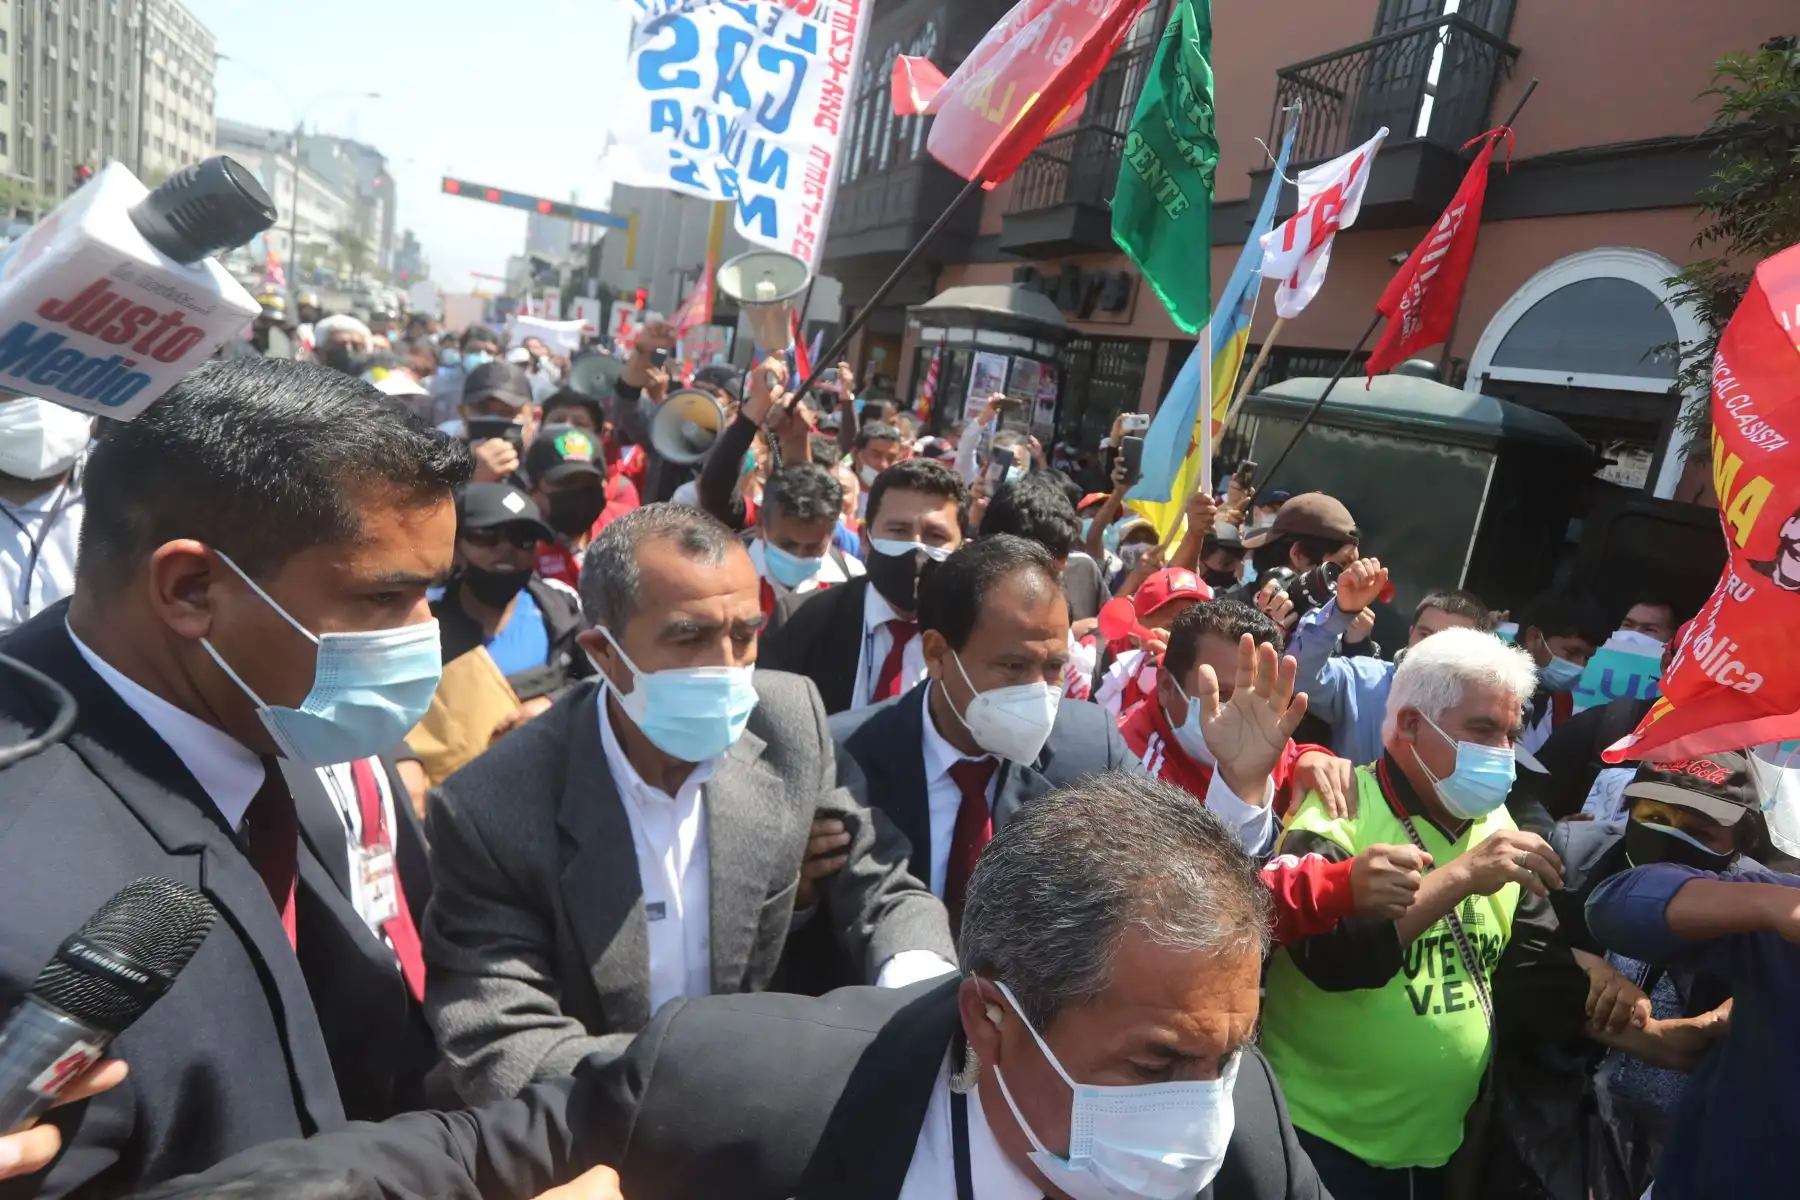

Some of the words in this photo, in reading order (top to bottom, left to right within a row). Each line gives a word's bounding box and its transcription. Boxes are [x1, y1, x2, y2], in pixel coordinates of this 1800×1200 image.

[0, 320, 152, 408] Medio
[36, 278, 206, 364] Justo
[1725, 394, 1789, 452] CLASISTA
